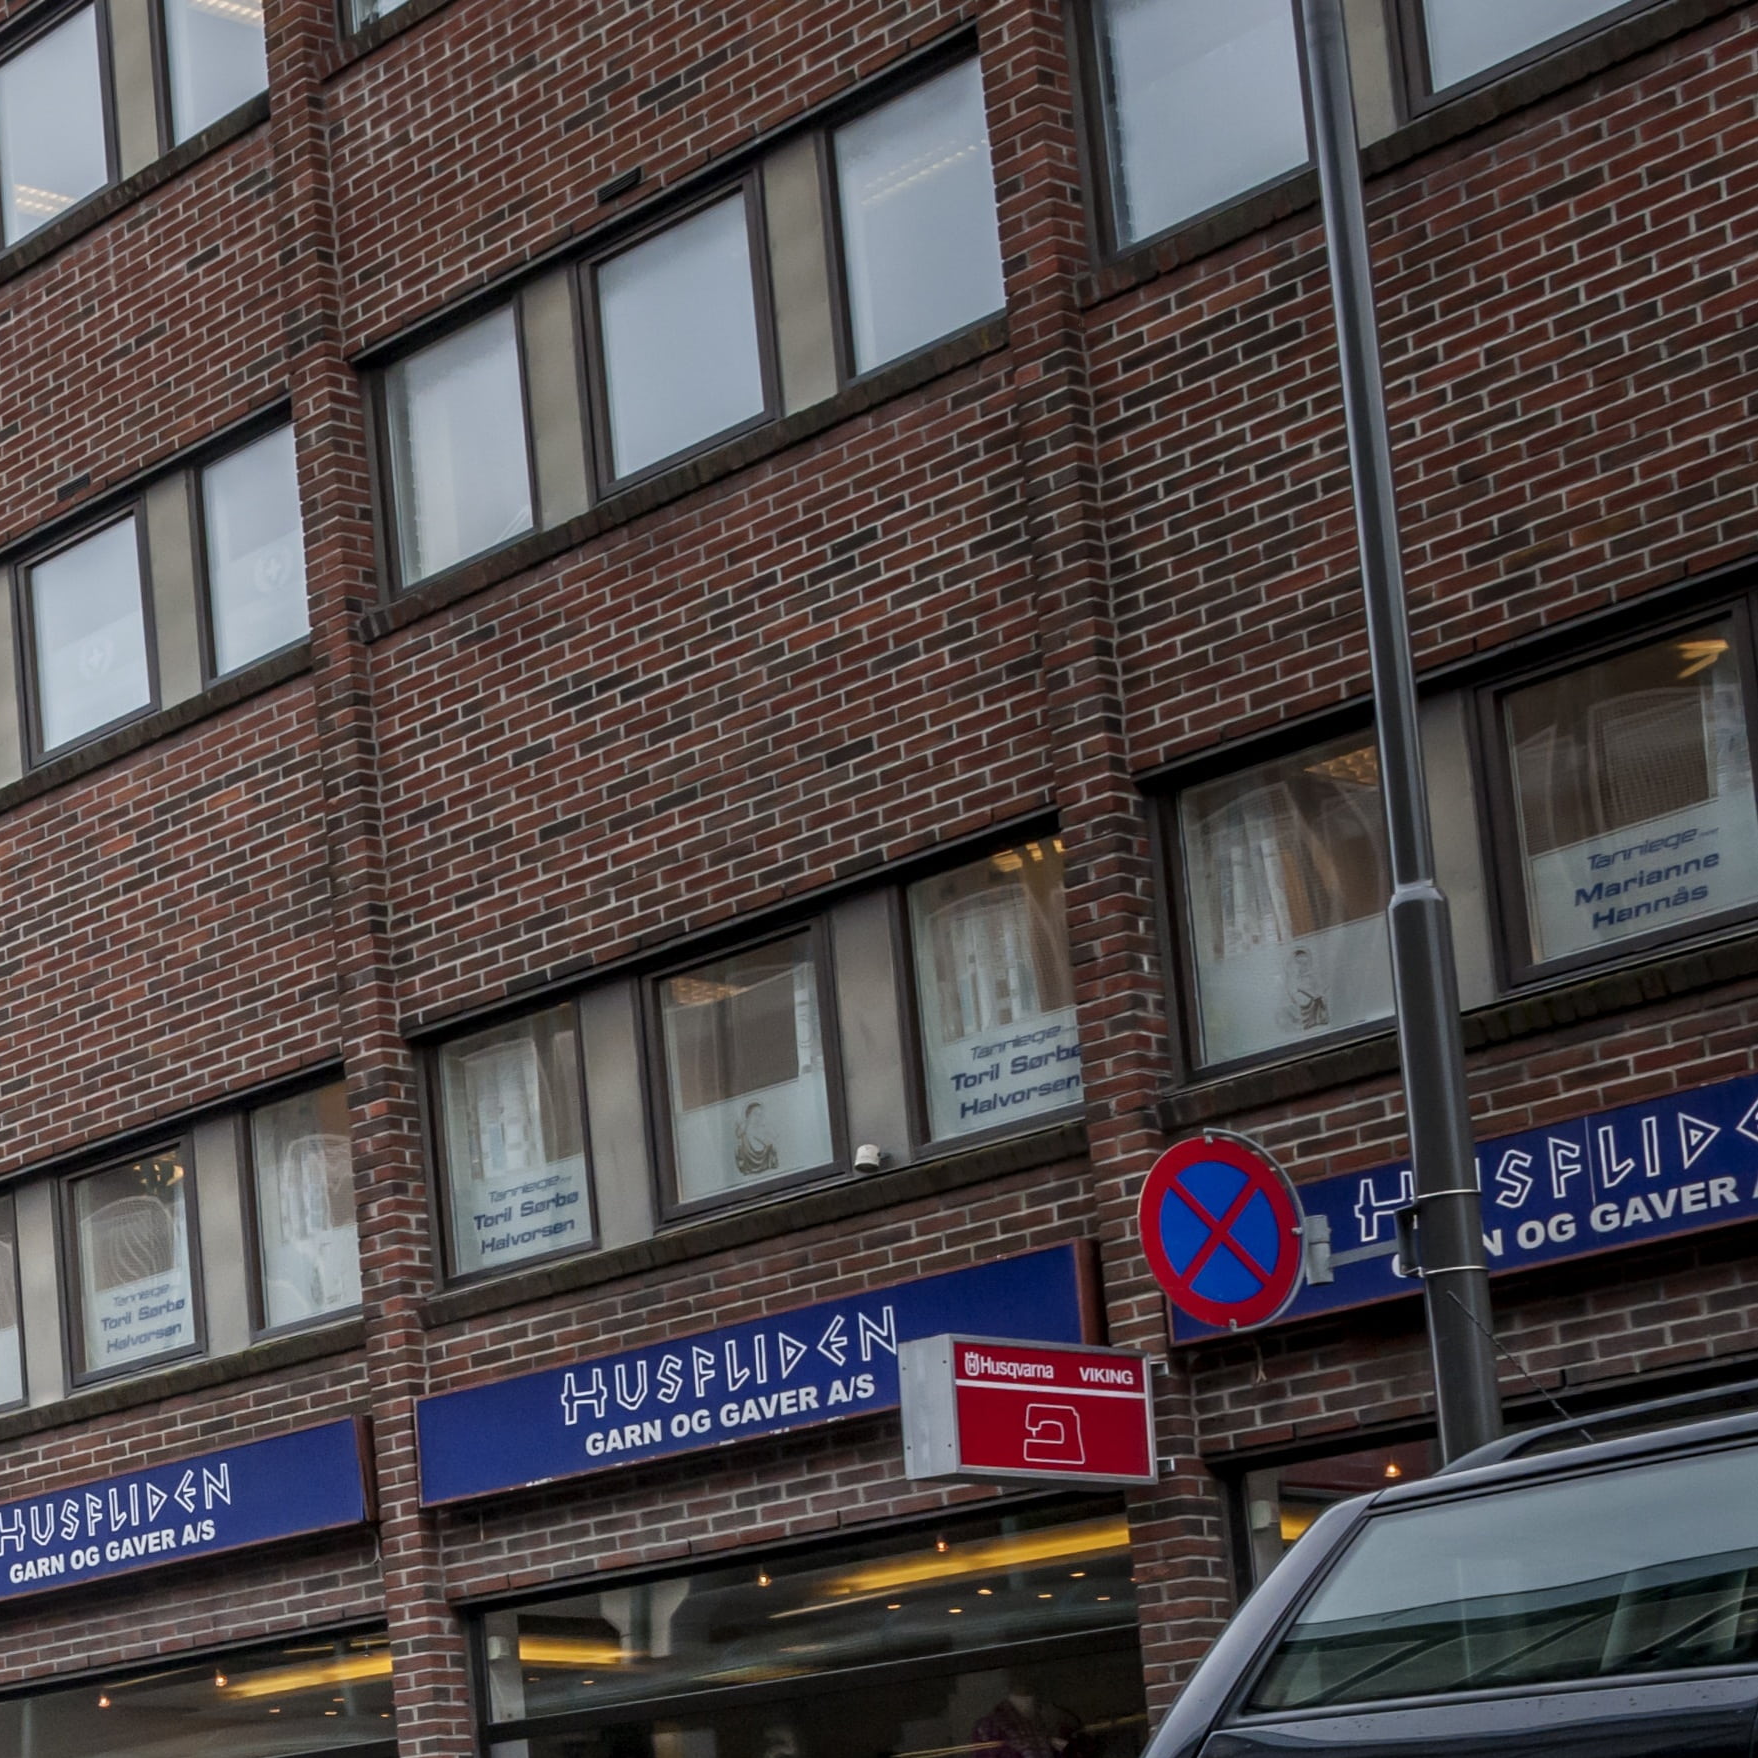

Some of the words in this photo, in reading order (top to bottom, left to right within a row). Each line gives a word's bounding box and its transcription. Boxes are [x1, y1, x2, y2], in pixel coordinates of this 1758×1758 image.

[1574, 852, 1720, 907] Marianne
[1592, 885, 1709, 930] Hannås
[950, 1063, 1000, 1091] Toril
[959, 1074, 1081, 1120] Halvorsen
[473, 1206, 512, 1231] Toril
[1516, 1213, 1576, 1249] OG
[1590, 1176, 1739, 1233] GAVER
[480, 1219, 575, 1254] Halvorsen
[106, 1323, 182, 1353] Halvorsen
[560, 1305, 898, 1426] HUSFLIDEN
[980, 1356, 1054, 1379] Husqvarna
[1079, 1366, 1134, 1385] VIKING
[585, 1419, 662, 1456] GARN
[670, 1410, 711, 1437] OG
[719, 1385, 817, 1428] GAVER
[828, 1374, 875, 1406] A/S
[9, 1553, 65, 1584] GARN
[70, 1546, 100, 1570] OG
[105, 1528, 176, 1562] GAVER
[181, 1519, 216, 1546] A/S
